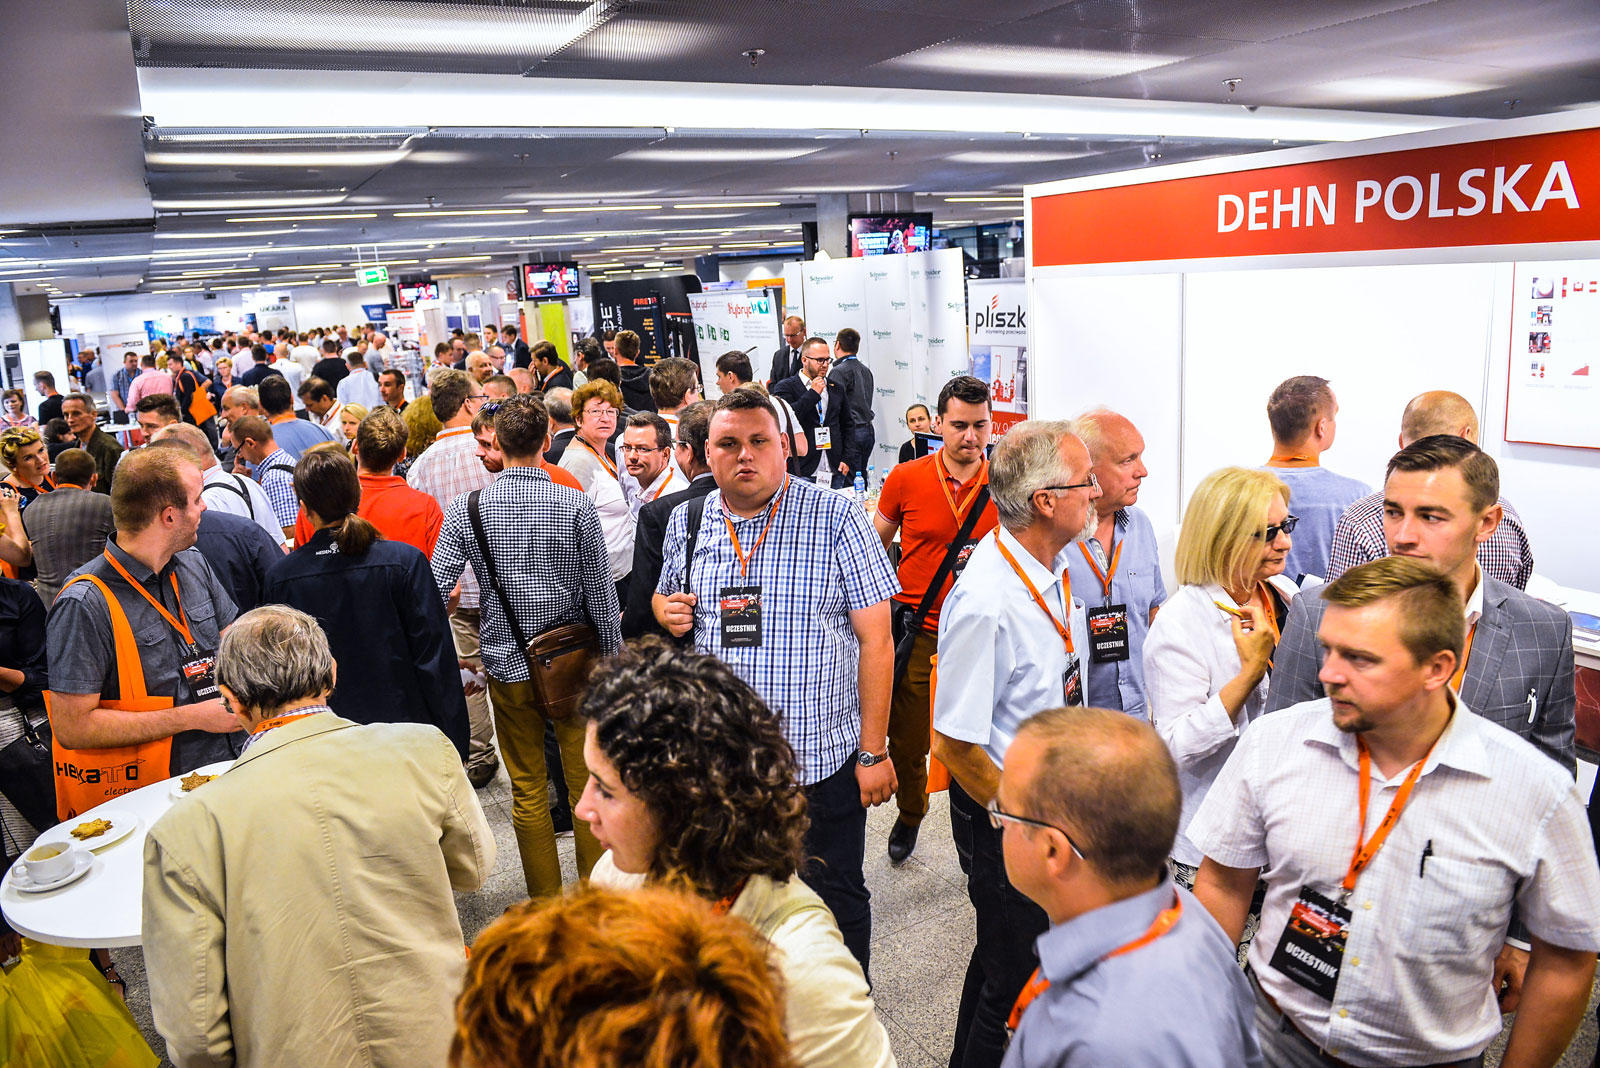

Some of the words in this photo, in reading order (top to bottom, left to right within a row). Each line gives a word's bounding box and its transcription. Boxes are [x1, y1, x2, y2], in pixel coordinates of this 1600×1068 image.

[1217, 183, 1336, 233] DEHN
[1355, 160, 1580, 223] POLSKA
[725, 624, 757, 633] UCZESTNIK
[1096, 640, 1125, 650] UCZESTNIK
[1284, 941, 1339, 979] UCZESTNIK
